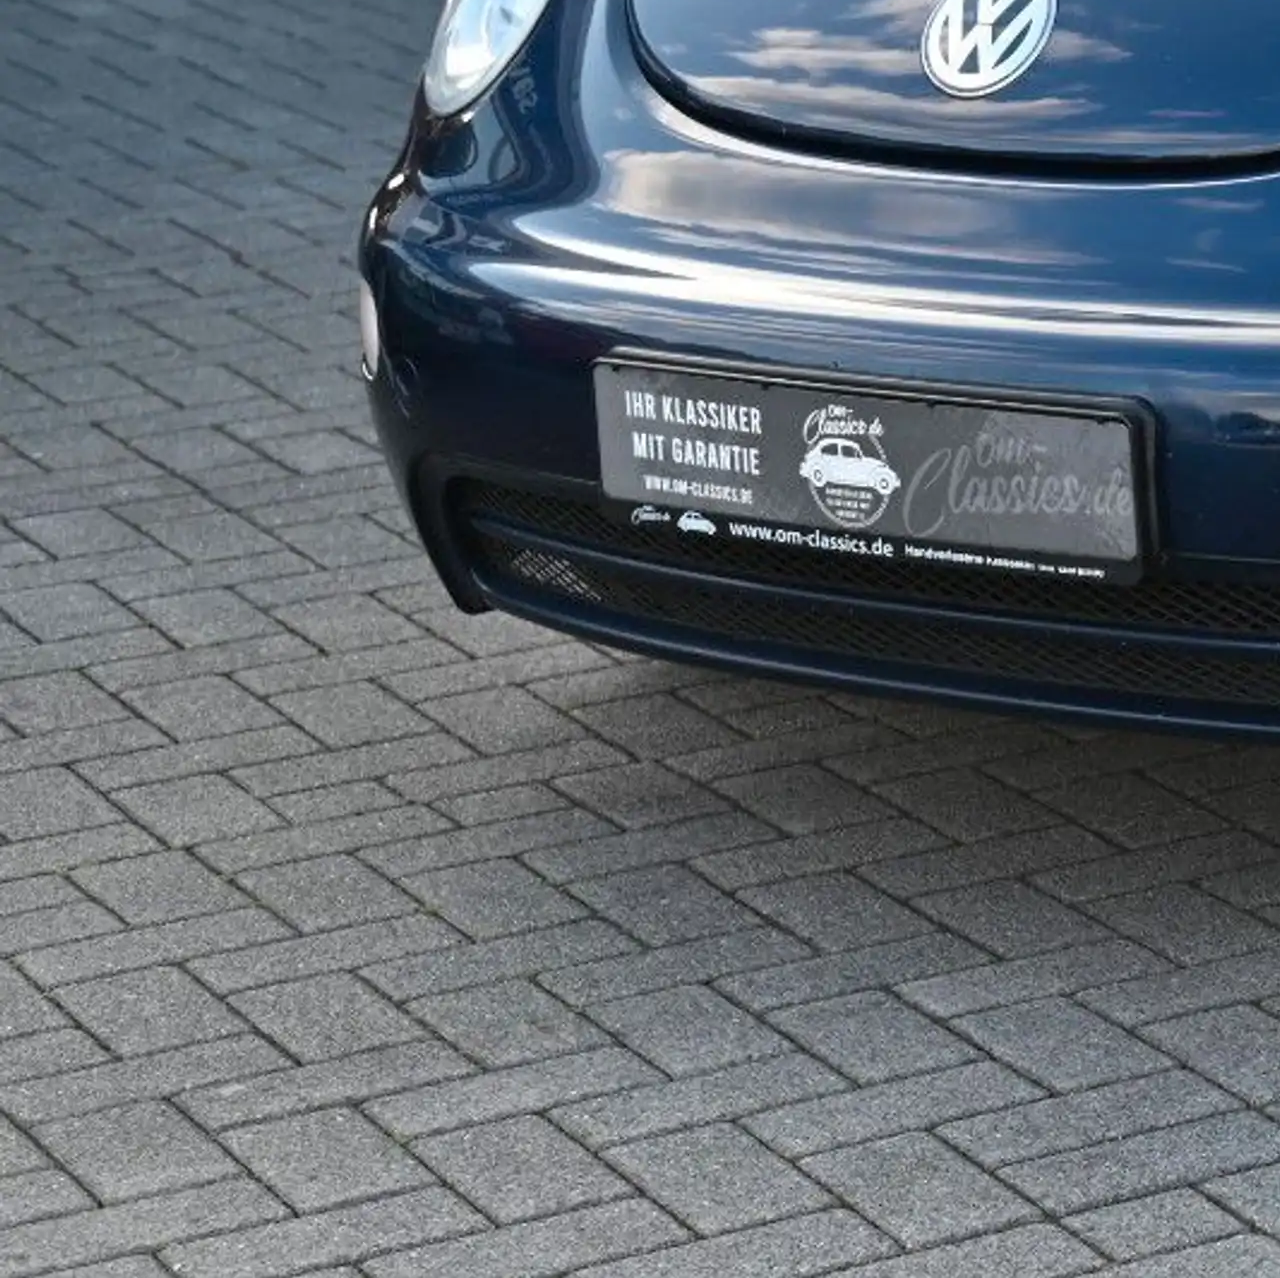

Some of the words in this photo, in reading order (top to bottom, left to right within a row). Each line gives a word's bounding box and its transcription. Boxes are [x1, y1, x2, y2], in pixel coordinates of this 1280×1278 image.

[624, 389, 657, 421] IHR
[662, 395, 763, 435] KLASSIKER
[632, 431, 666, 461] MIT
[671, 437, 761, 476] GARANTIE
[643, 474, 754, 506] WWW.OM-CLASSICS.DE
[903, 447, 1134, 538] Classics.de
[728, 522, 895, 558] www.om-classics.de
